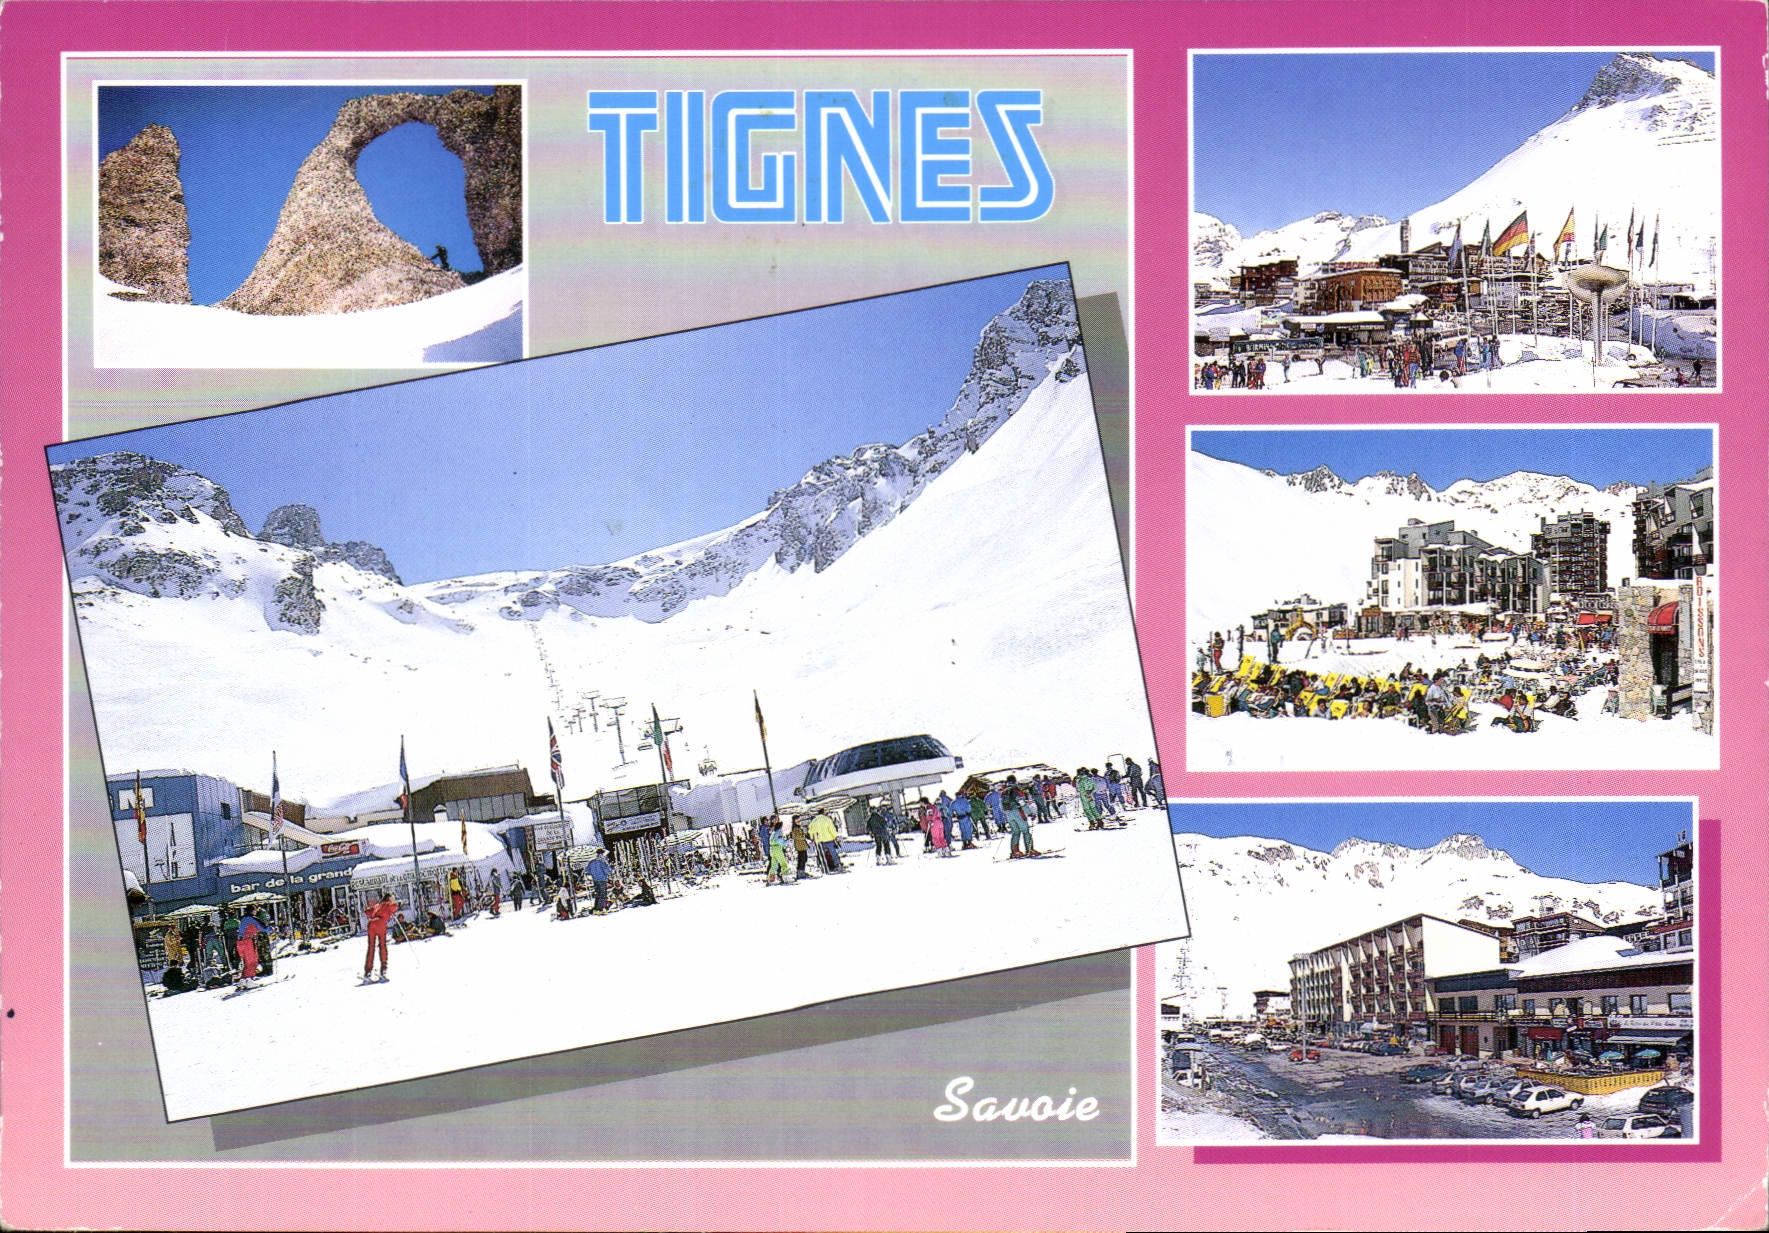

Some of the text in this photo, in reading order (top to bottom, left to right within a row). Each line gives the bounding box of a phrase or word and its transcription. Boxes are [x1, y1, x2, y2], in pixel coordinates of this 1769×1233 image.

[230, 882, 260, 894] bar
[265, 878, 286, 889] de
[289, 875, 304, 885] la
[308, 867, 353, 884] grand
